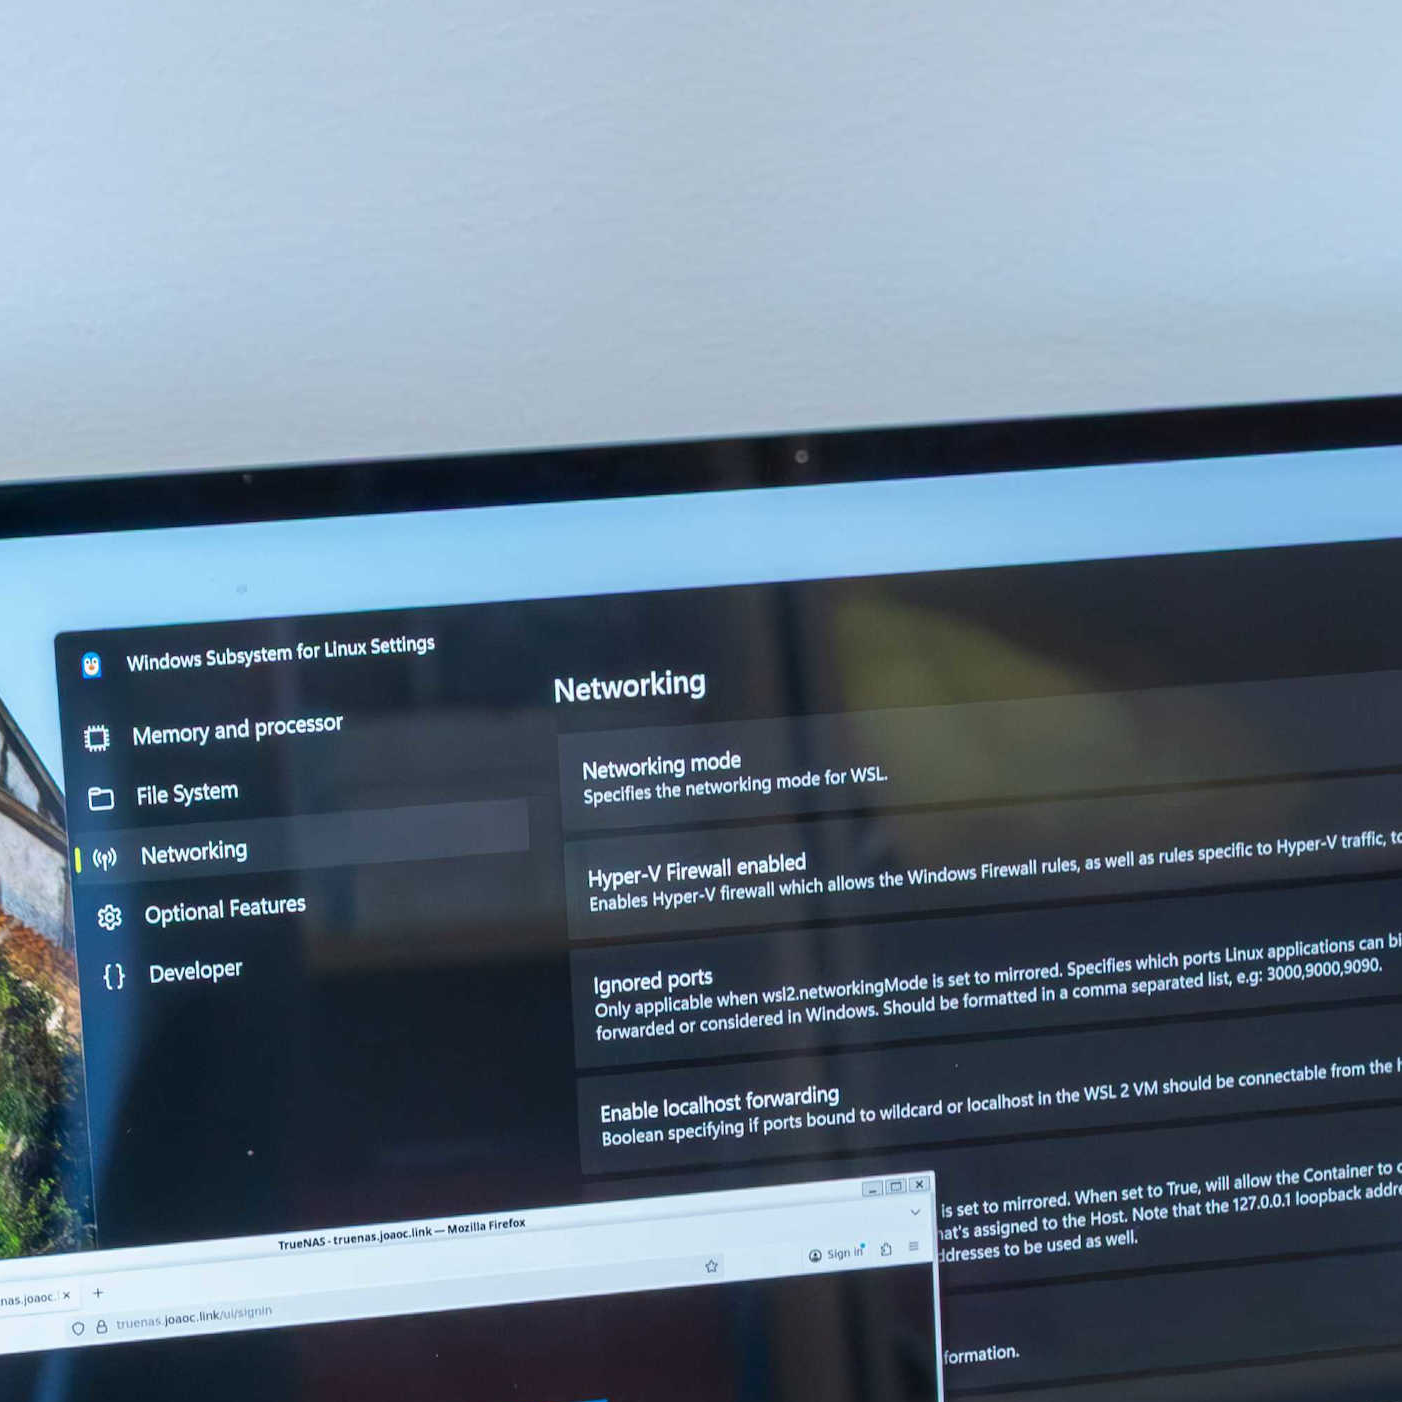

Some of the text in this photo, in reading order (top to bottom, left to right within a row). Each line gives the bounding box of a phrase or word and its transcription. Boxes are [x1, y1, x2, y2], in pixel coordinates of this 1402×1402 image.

[126, 635, 436, 672] Windows Subsystem for Linux Settings
[554, 669, 706, 703] Networking
[133, 715, 344, 746] Memory and processor
[582, 750, 742, 780] Networking mode
[137, 783, 239, 807] File System
[583, 766, 888, 808] Specifies the networking mode for WSL.
[141, 839, 248, 865] Networking
[588, 851, 807, 891] Hyper-V Firewall enabled
[589, 892, 648, 912] Enables
[652, 886, 716, 909] Hyper-V
[719, 880, 775, 901] firewall
[778, 877, 824, 896] which
[827, 874, 875, 892] allows
[878, 871, 904, 888] the
[907, 866, 977, 885] Windows
[981, 859, 1037, 879] Firewall
[1041, 857, 1081, 874] rules,
[1084, 857, 1102, 870] as
[1104, 850, 1135, 869] well
[1138, 853, 1155, 866] as
[1158, 847, 1195, 864] rules
[1197, 841, 1253, 865] specific
[1256, 842, 1273, 856] to
[1276, 834, 1338, 858] Hyper-V
[1341, 830, 1387, 849] traffic,
[145, 897, 307, 929] Optional Features
[149, 960, 243, 984] Developer
[593, 968, 713, 999] Ignored ports
[600, 1085, 840, 1123] Enable localhost forwarding
[278, 1236, 326, 1251] TrueNAS
[333, 1226, 433, 1245] truenas.joaoc.link
[447, 1221, 486, 1234] Mozilla
[488, 1218, 526, 1231] Firefox
[827, 1246, 863, 1261] Sign in
[116, 1305, 273, 1330] truenas.joaoc.link/ui/signin
